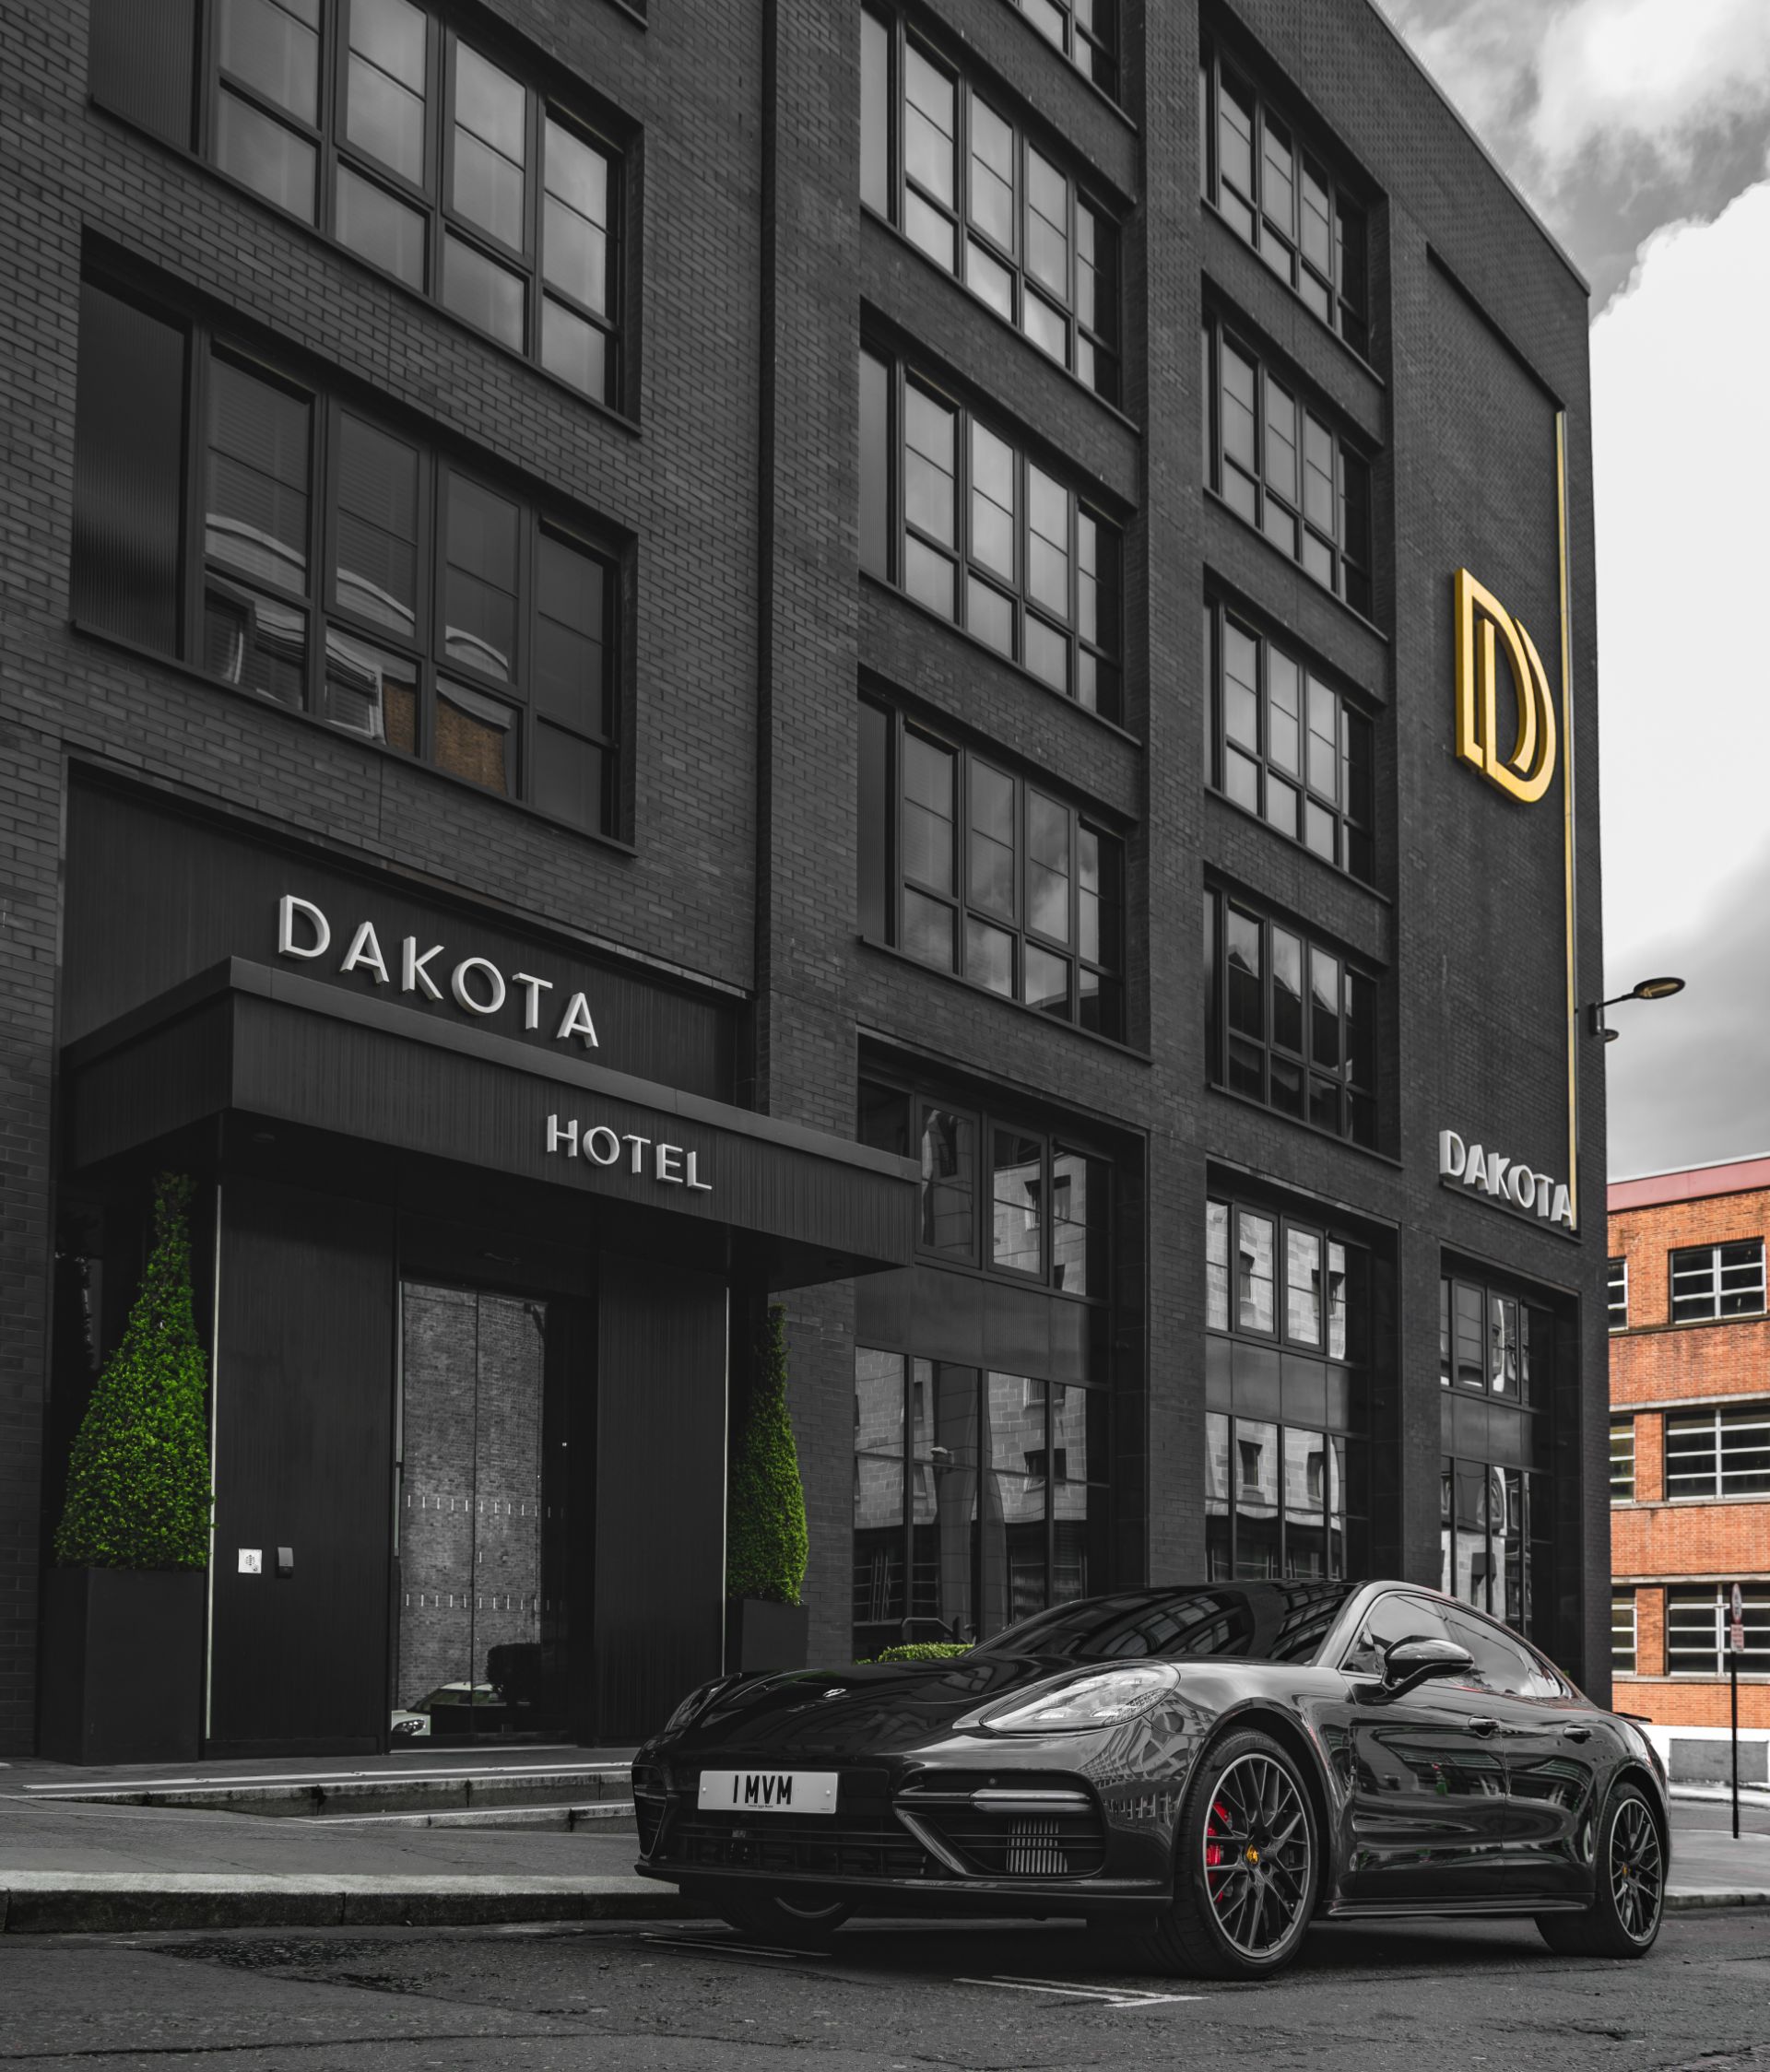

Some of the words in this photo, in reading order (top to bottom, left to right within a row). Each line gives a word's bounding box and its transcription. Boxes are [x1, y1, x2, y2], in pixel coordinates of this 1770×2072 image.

[277, 894, 599, 1049] DAKOTA
[547, 1113, 713, 1191] HOTEL
[1438, 1129, 1574, 1228] DAKOTA
[744, 1775, 793, 1805] MVM
